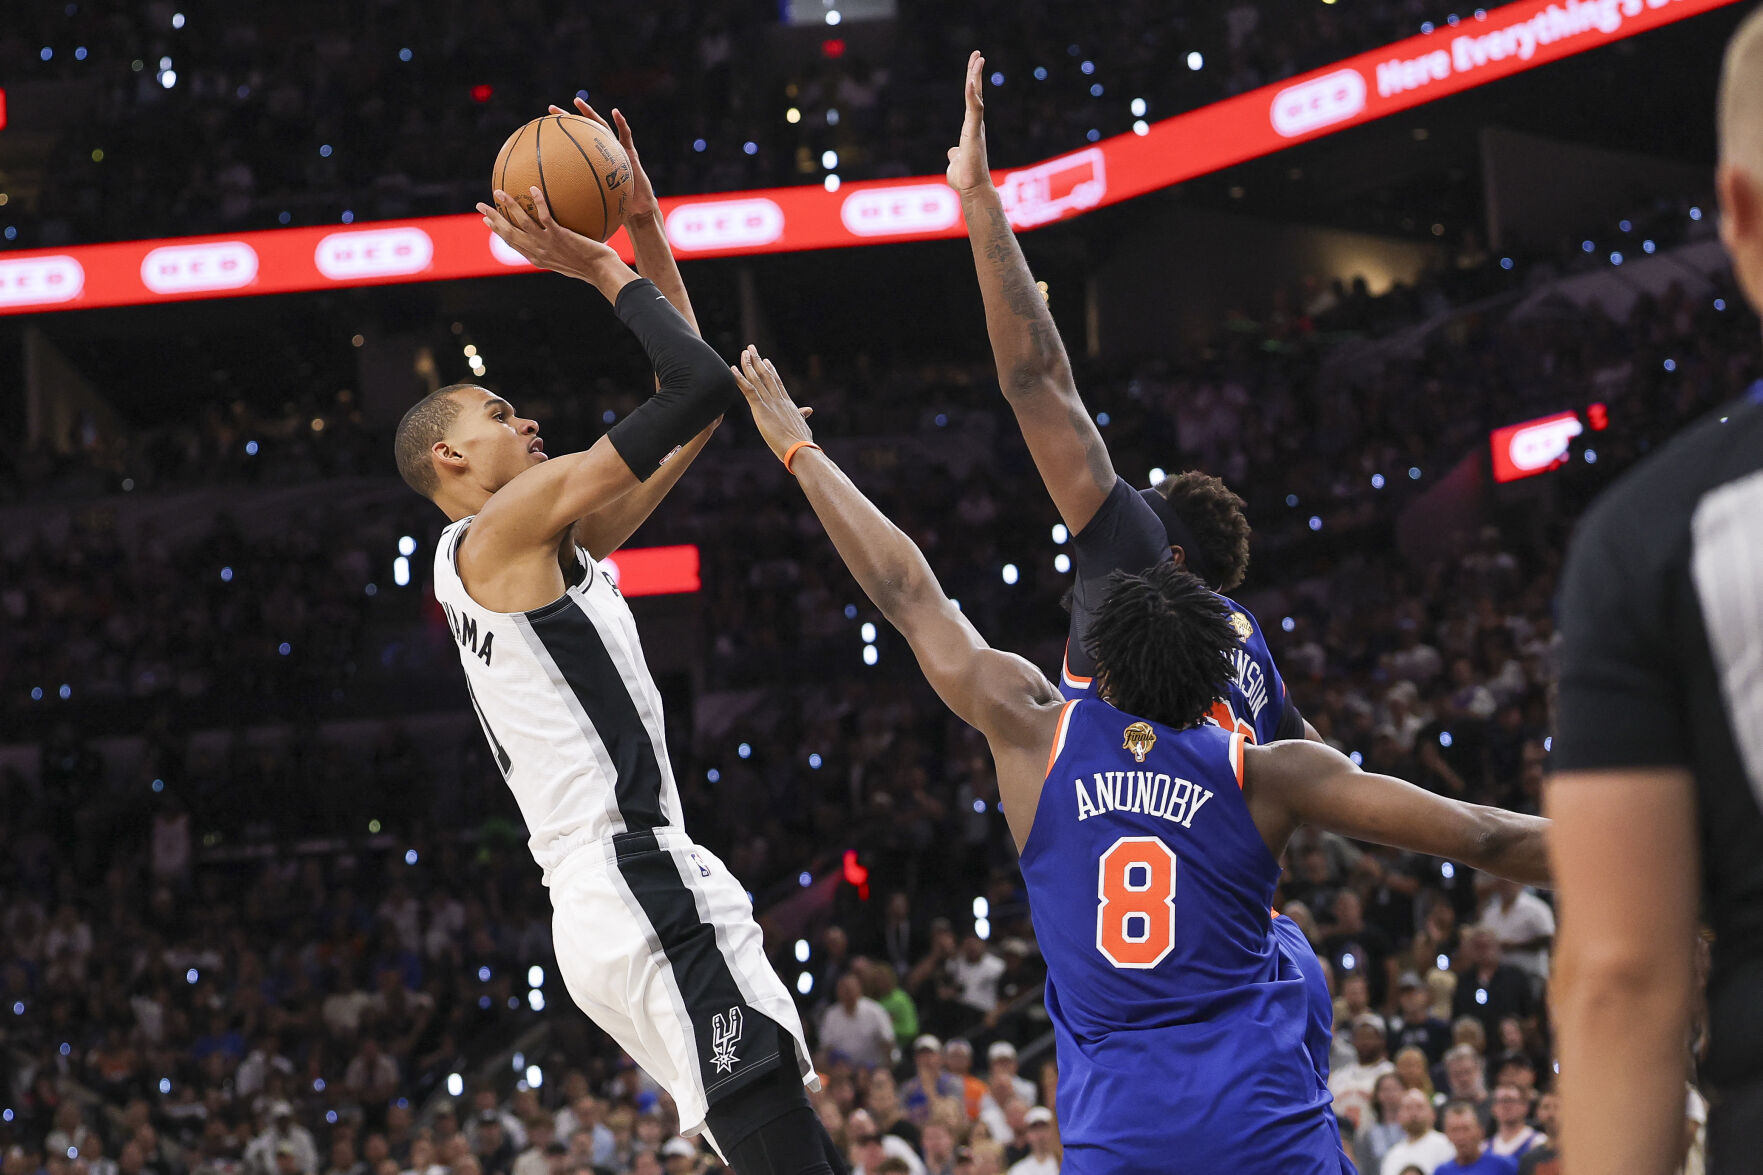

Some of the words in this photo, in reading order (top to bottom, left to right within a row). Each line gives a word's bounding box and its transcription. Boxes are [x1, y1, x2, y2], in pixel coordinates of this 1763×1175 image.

[1376, 50, 1450, 97] Here
[1452, 0, 1643, 72] Everythings
[1123, 729, 1155, 748] Finals
[1075, 771, 1213, 829] ANUNOBY
[1096, 836, 1177, 969] 8
